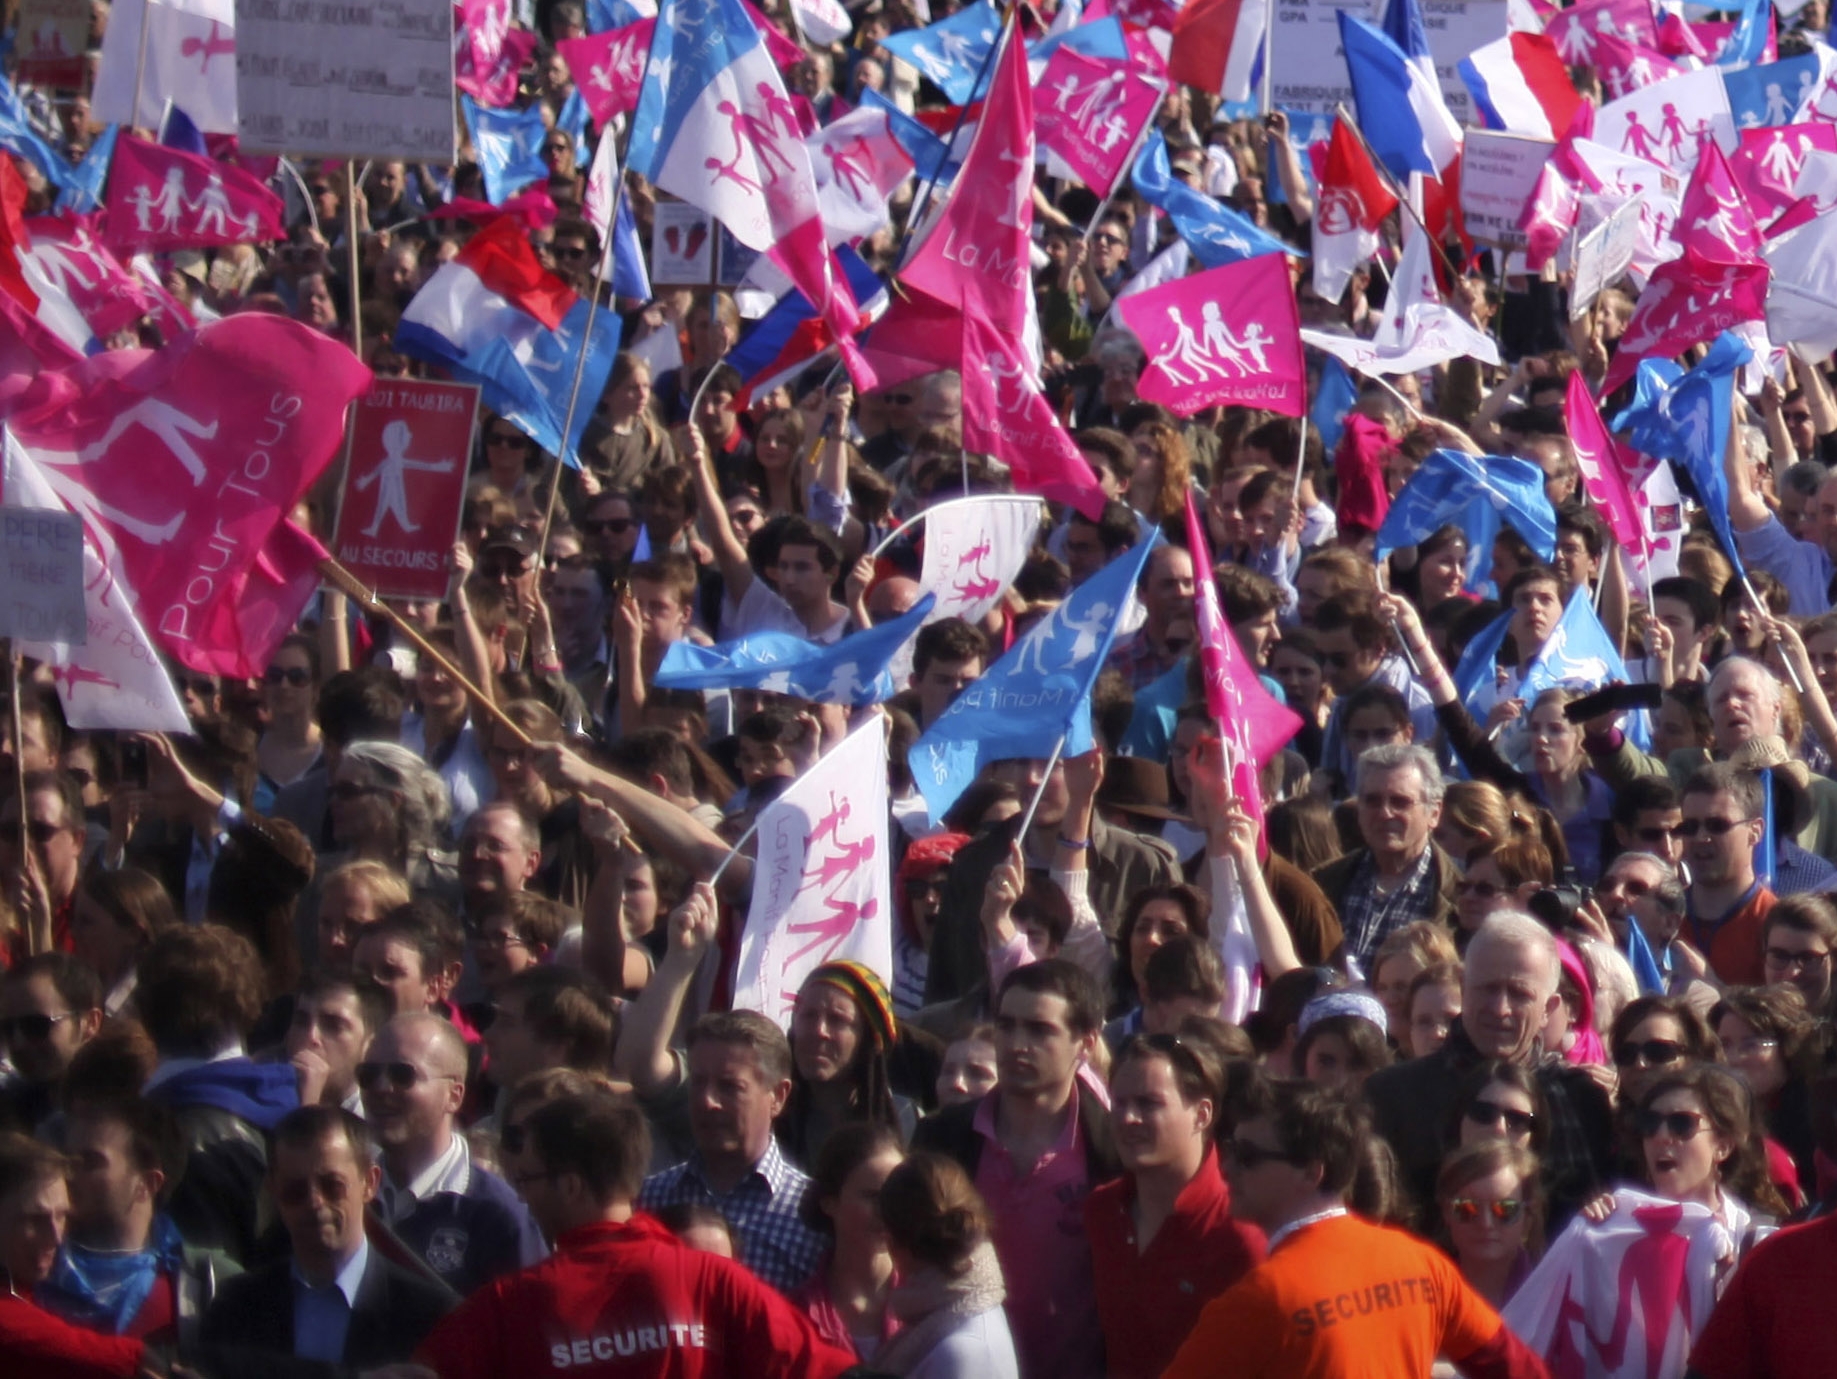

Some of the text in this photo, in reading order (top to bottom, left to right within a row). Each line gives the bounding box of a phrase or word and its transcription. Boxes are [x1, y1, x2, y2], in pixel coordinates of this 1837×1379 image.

[398, 391, 466, 413] TAUBIRA
[158, 390, 304, 642] Pour Tous
[339, 544, 359, 564] AU
[362, 547, 439, 571] SECOURS
[1292, 1277, 1436, 1337] SECURITE
[551, 1322, 705, 1369] SECURITE
